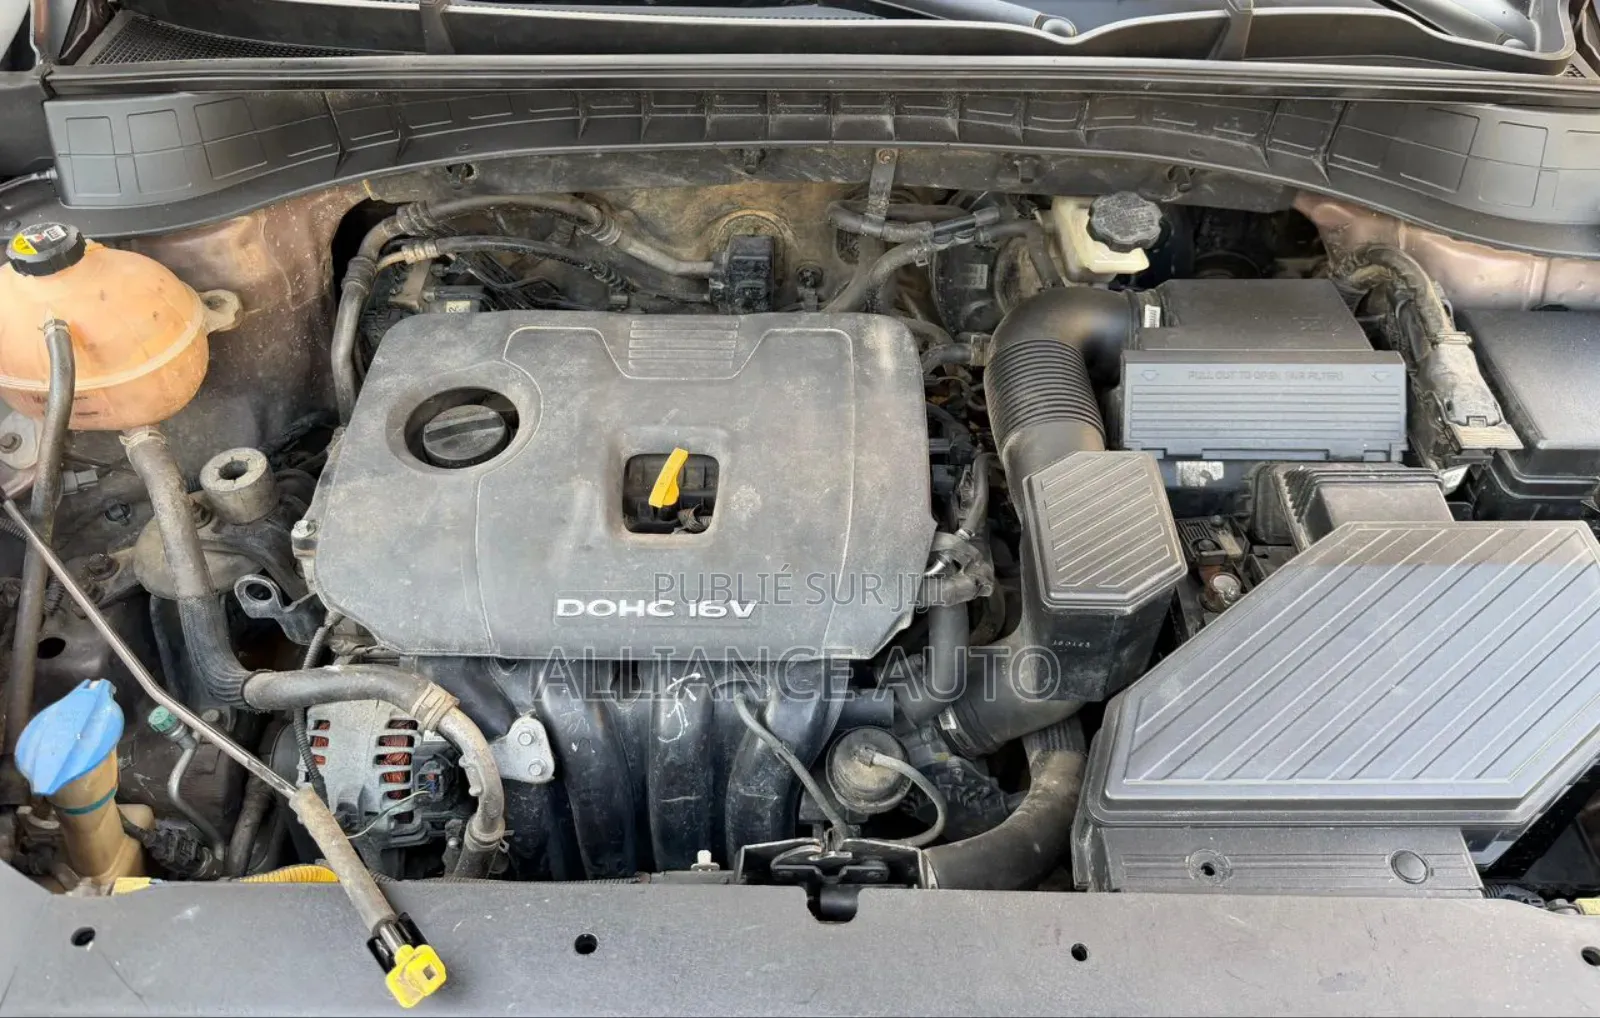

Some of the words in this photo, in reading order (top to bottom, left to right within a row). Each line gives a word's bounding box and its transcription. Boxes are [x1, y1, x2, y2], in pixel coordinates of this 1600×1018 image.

[1214, 371, 1237, 380] OUT
[1240, 371, 1250, 380] TO
[556, 599, 675, 617] DOHC
[689, 599, 757, 619] 16V
